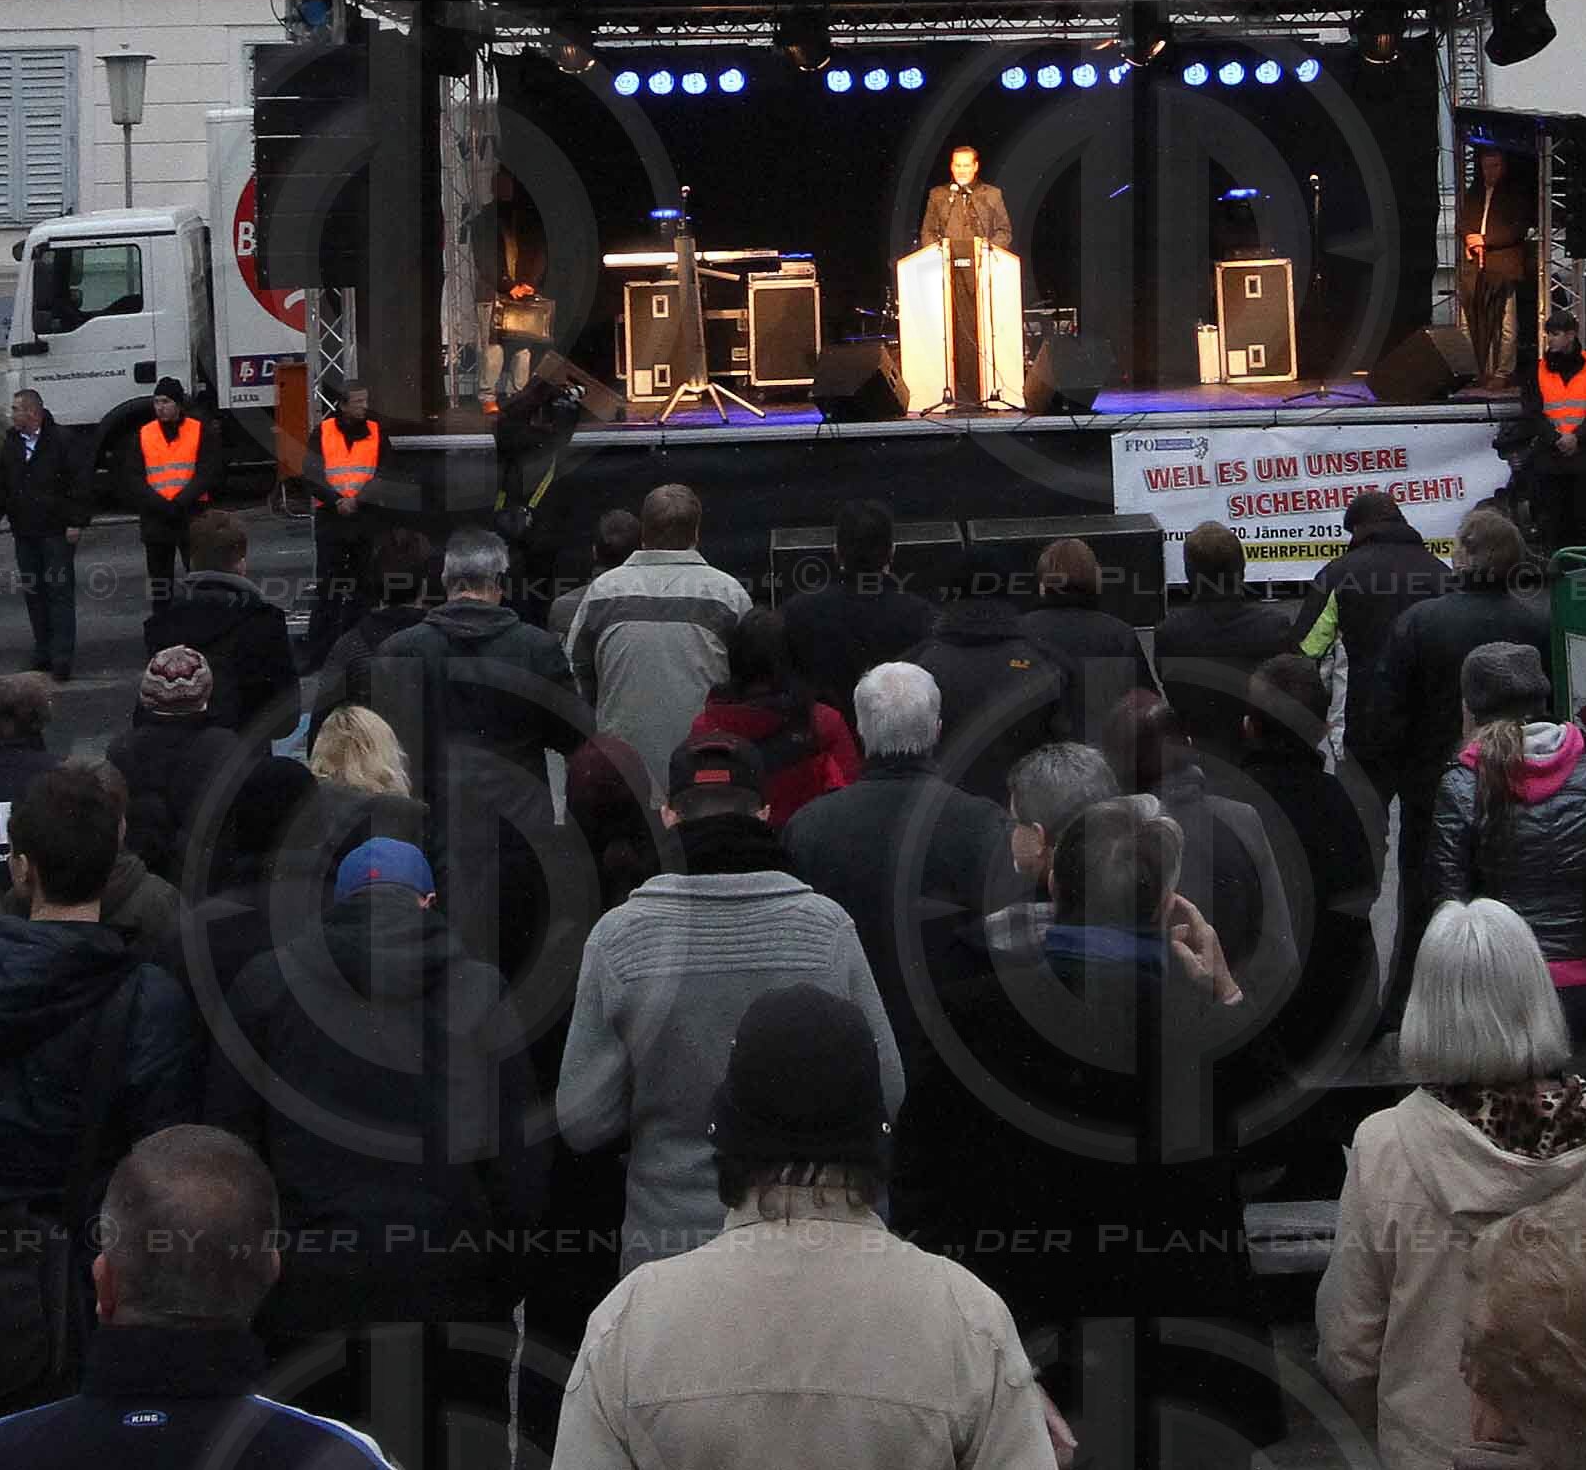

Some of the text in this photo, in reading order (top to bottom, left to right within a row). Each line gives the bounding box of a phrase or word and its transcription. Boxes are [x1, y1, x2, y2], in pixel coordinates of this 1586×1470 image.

[1144, 446, 1408, 491] WEIL ES UM UNSERE
[1229, 475, 1466, 519] SICHERHE GEHT!
[1254, 526, 1303, 539] Jänner
[1309, 525, 1342, 538] 2013
